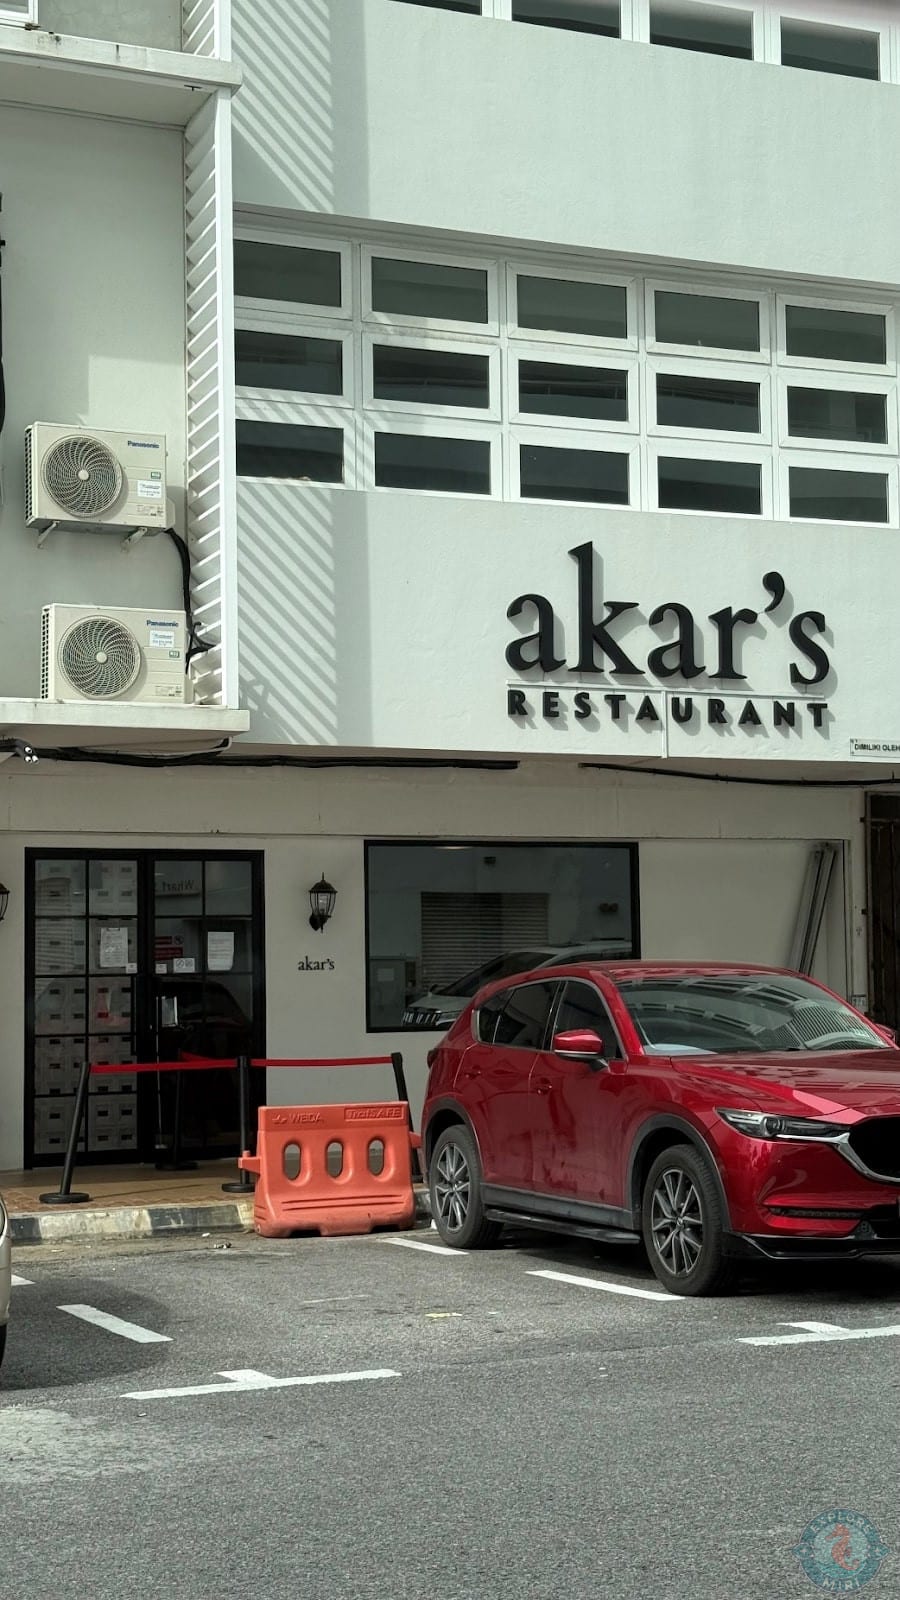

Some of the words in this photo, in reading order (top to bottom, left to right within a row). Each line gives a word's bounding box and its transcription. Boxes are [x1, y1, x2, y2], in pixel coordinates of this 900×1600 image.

[127, 440, 160, 449] Panasonic
[505, 540, 831, 686] akar's
[146, 619, 179, 628] Panasonic
[507, 689, 828, 728] RESTAURANT
[297, 955, 335, 971] akar's
[289, 1112, 325, 1124] WEDA
